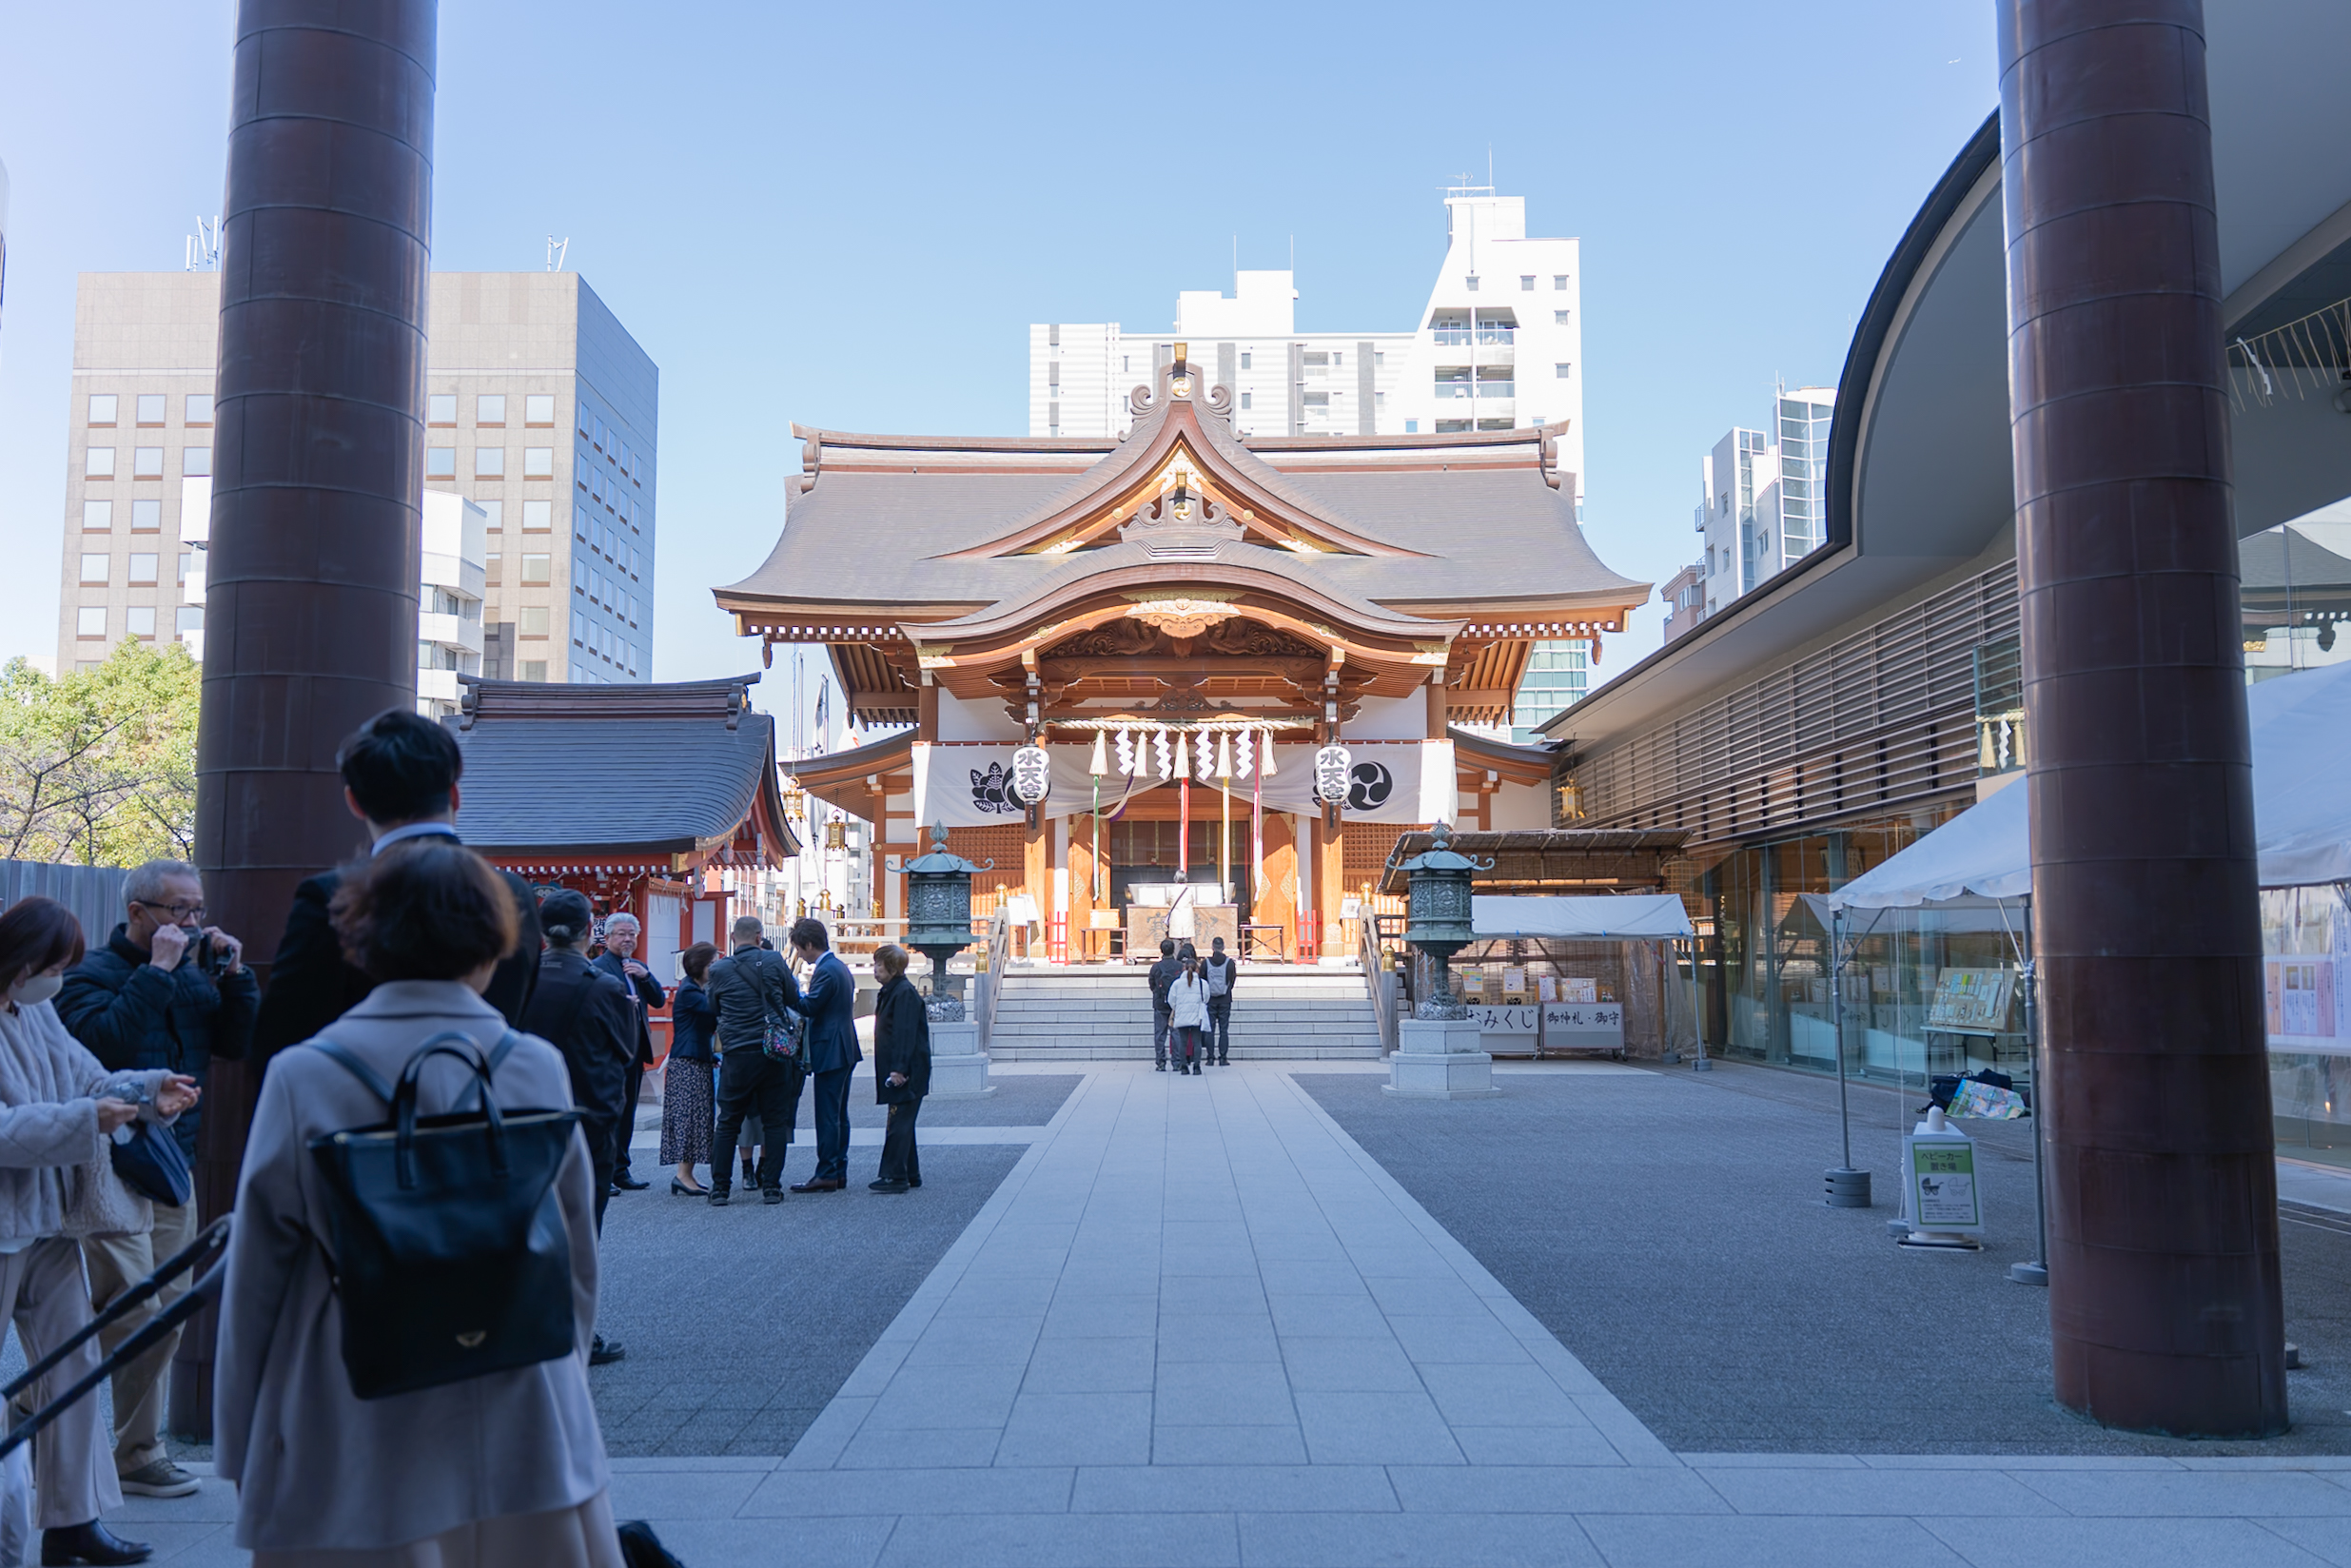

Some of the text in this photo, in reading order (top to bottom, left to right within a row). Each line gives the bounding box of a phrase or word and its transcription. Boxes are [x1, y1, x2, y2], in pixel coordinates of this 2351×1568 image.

[1017, 749, 1043, 799] 水天宮
[1320, 749, 1345, 800] 水天宮
[1930, 1162, 1957, 1171] 置き場
